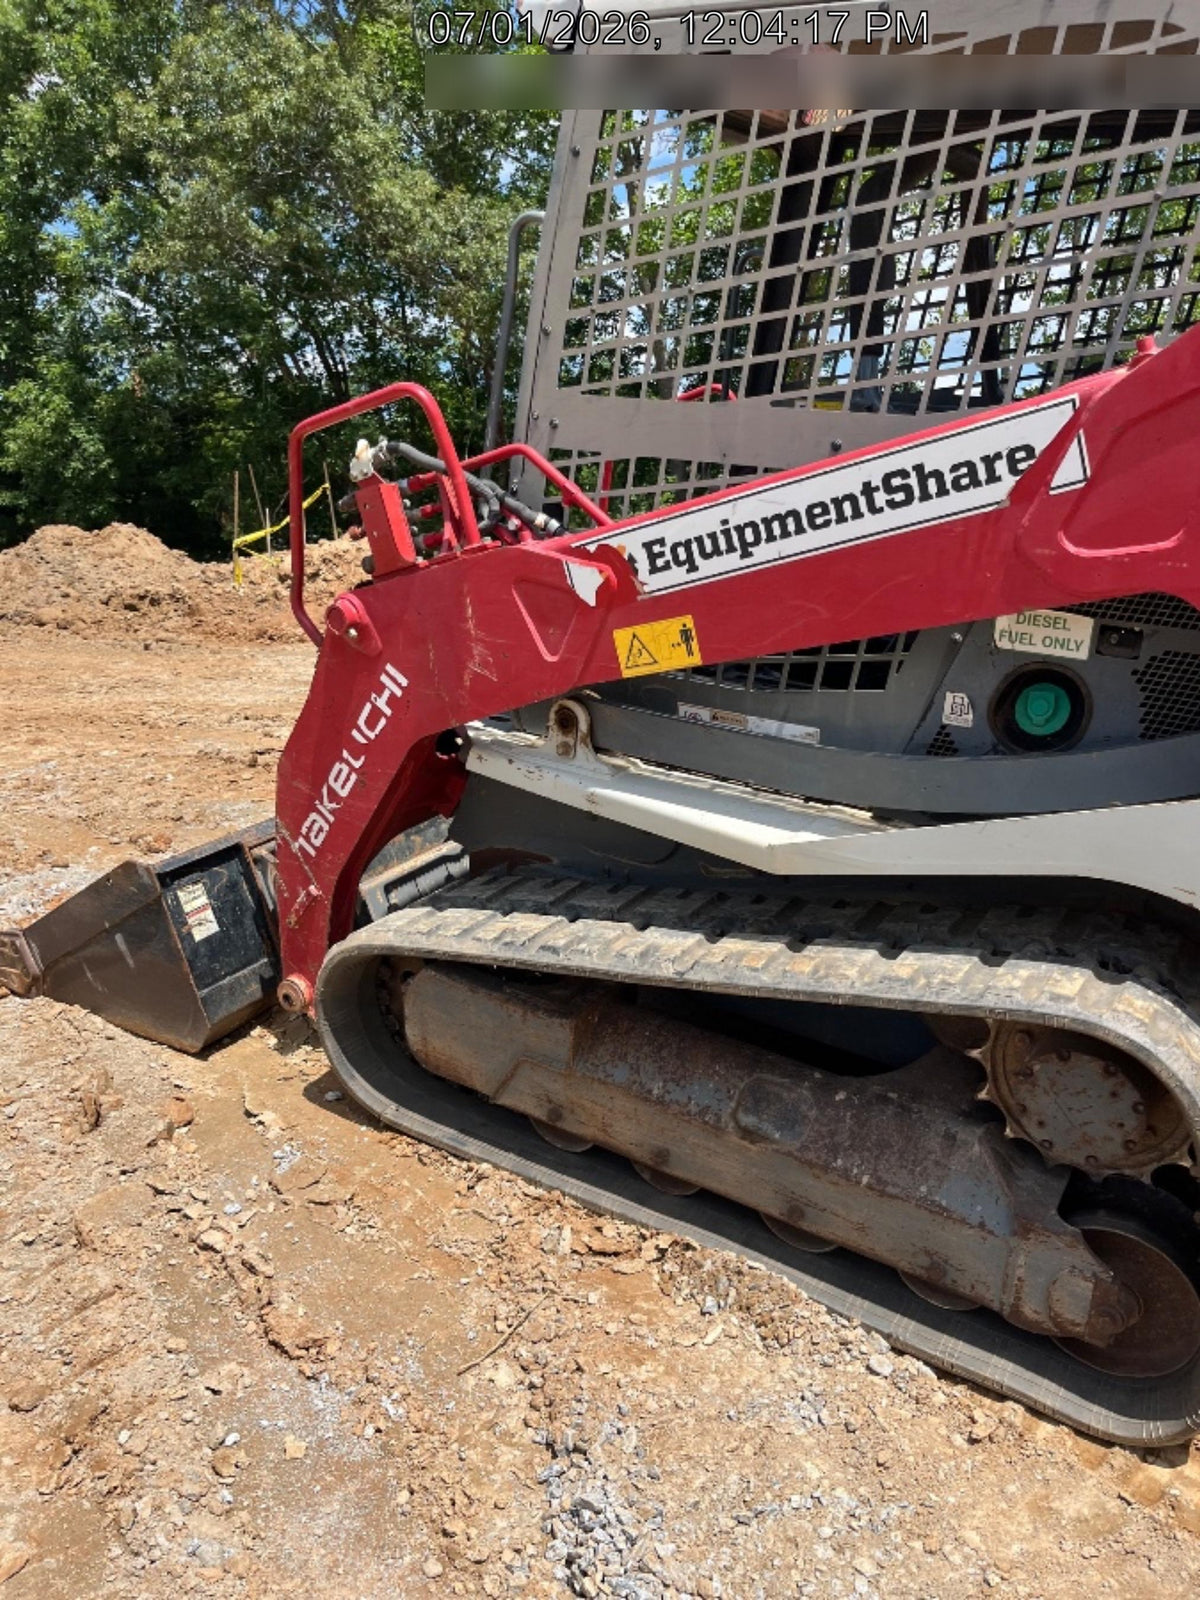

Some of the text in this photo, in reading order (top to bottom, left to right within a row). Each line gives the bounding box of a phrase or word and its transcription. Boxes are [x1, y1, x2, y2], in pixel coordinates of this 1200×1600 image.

[641, 442, 1037, 576] EquipmentShare
[1015, 612, 1072, 632] DIESEL
[998, 628, 1085, 653] FUEL ONLY
